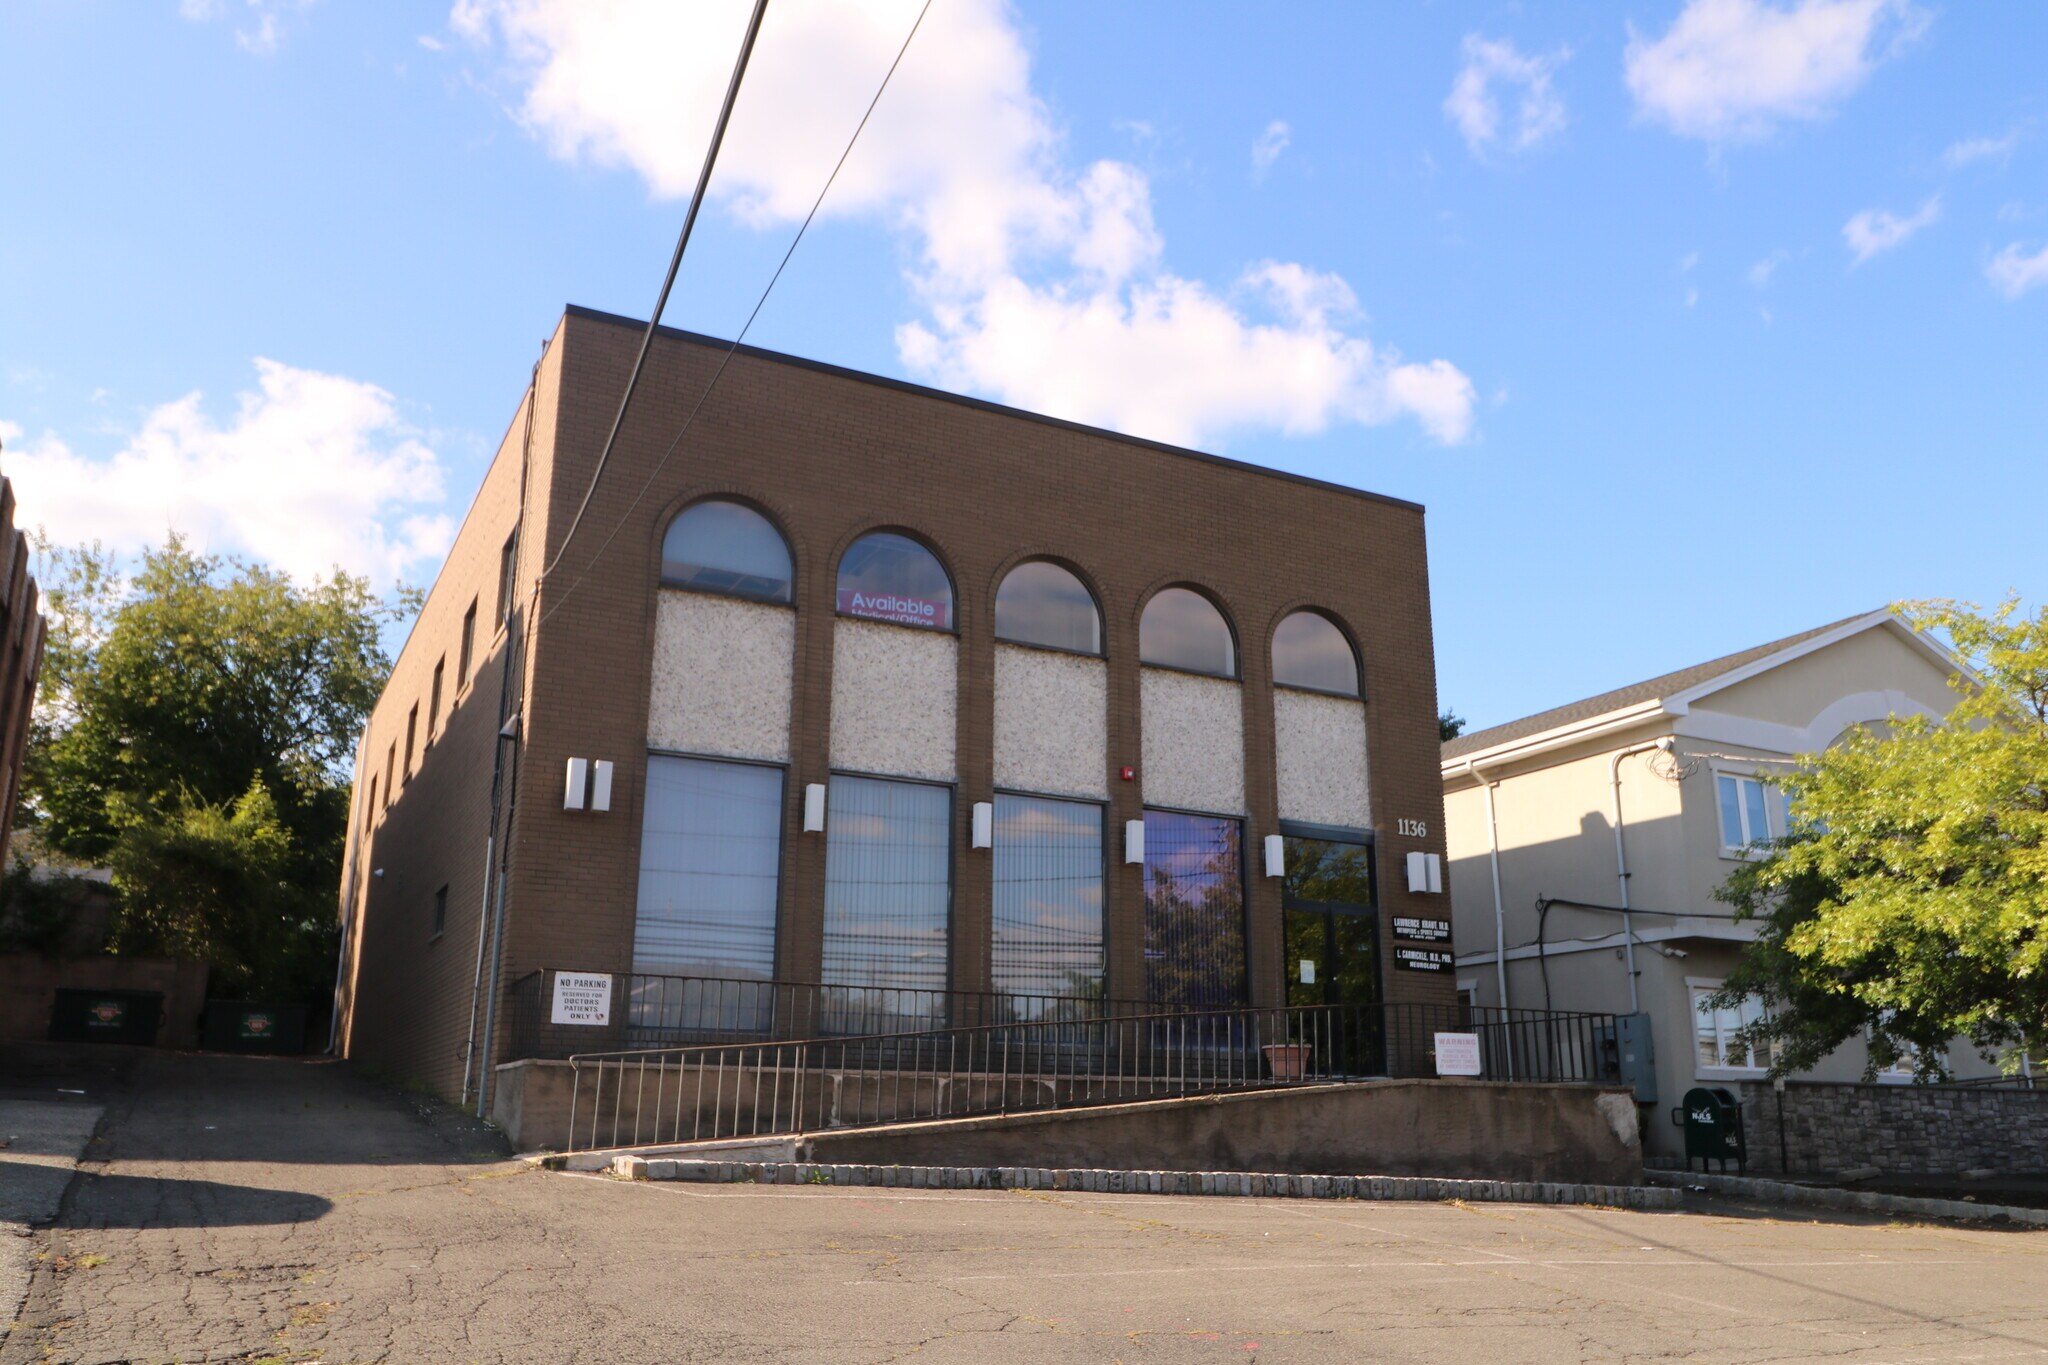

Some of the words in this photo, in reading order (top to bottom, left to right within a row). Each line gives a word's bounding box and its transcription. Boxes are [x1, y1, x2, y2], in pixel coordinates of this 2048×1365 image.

[851, 592, 934, 616] Available
[1397, 818, 1427, 838] 1136
[1394, 917, 1420, 928] LAWRENCE
[1409, 961, 1441, 970] NEUROLOGY
[560, 979, 571, 987] NO
[574, 979, 607, 989] PARKING
[1692, 1112, 1711, 1120] NJLS
